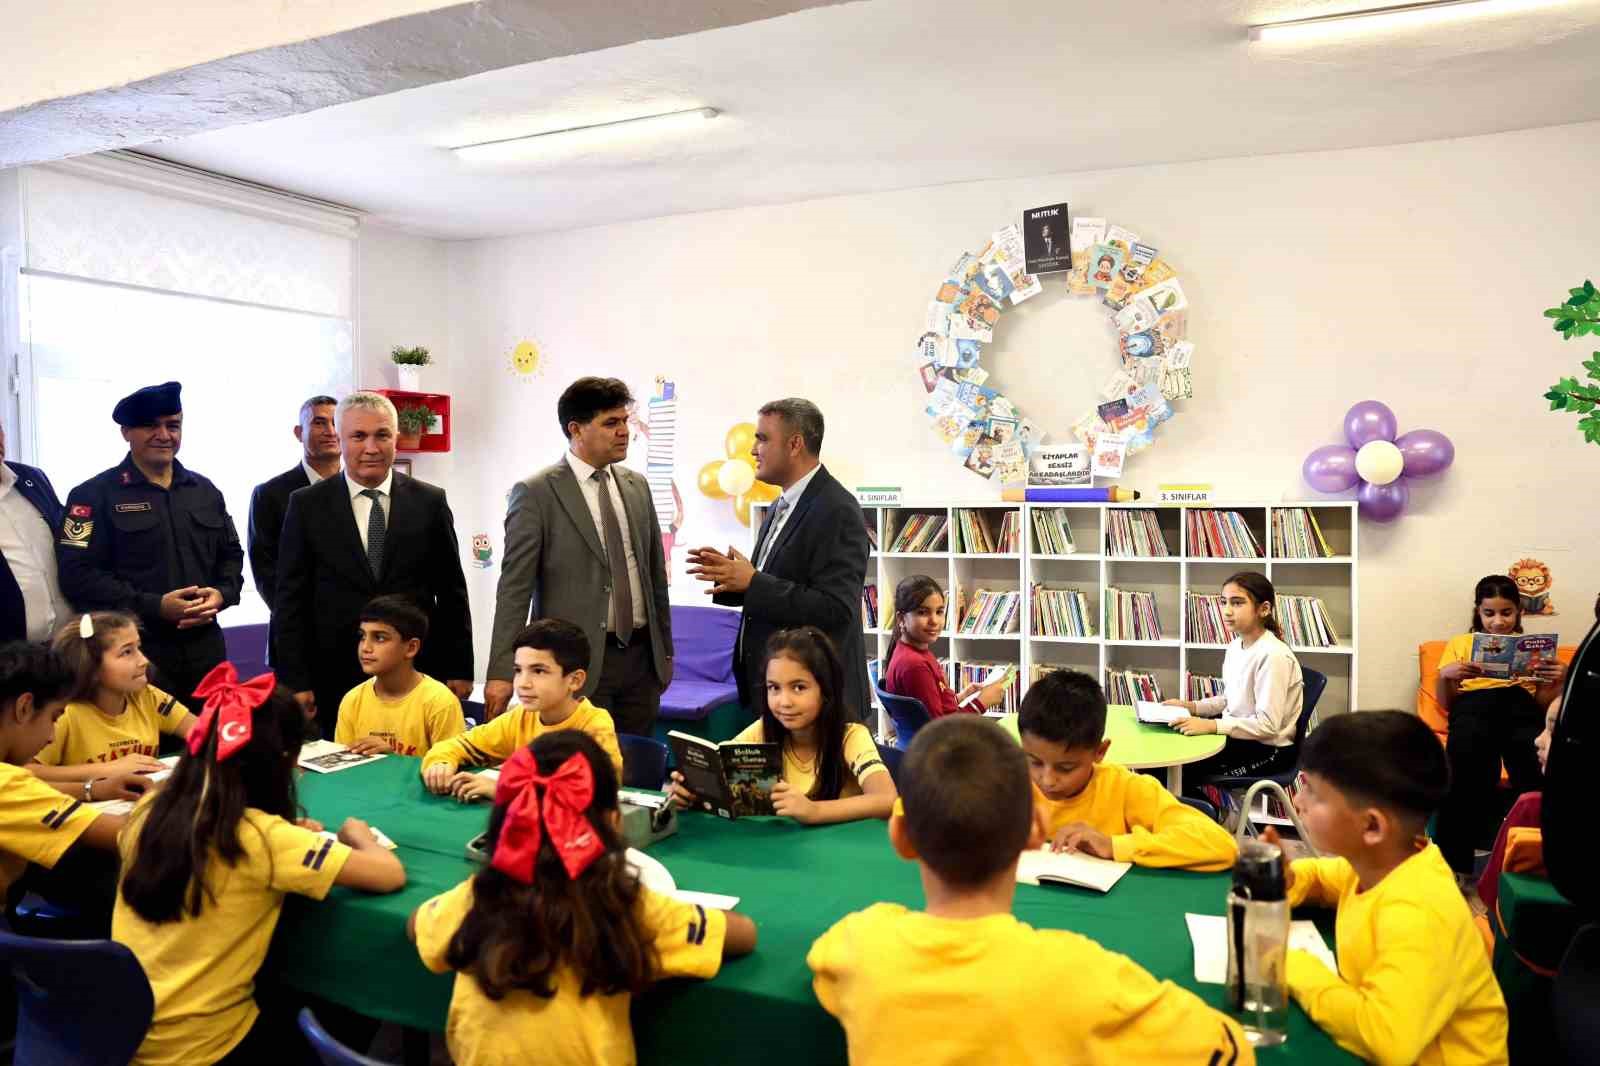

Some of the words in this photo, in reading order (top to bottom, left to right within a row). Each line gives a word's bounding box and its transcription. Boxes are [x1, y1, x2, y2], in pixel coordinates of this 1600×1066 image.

[1031, 208, 1059, 220] NUTUK
[867, 494, 898, 502] SINIFLAR
[1160, 493, 1169, 501] 3.
[1170, 493, 1208, 501] SINIFLAR
